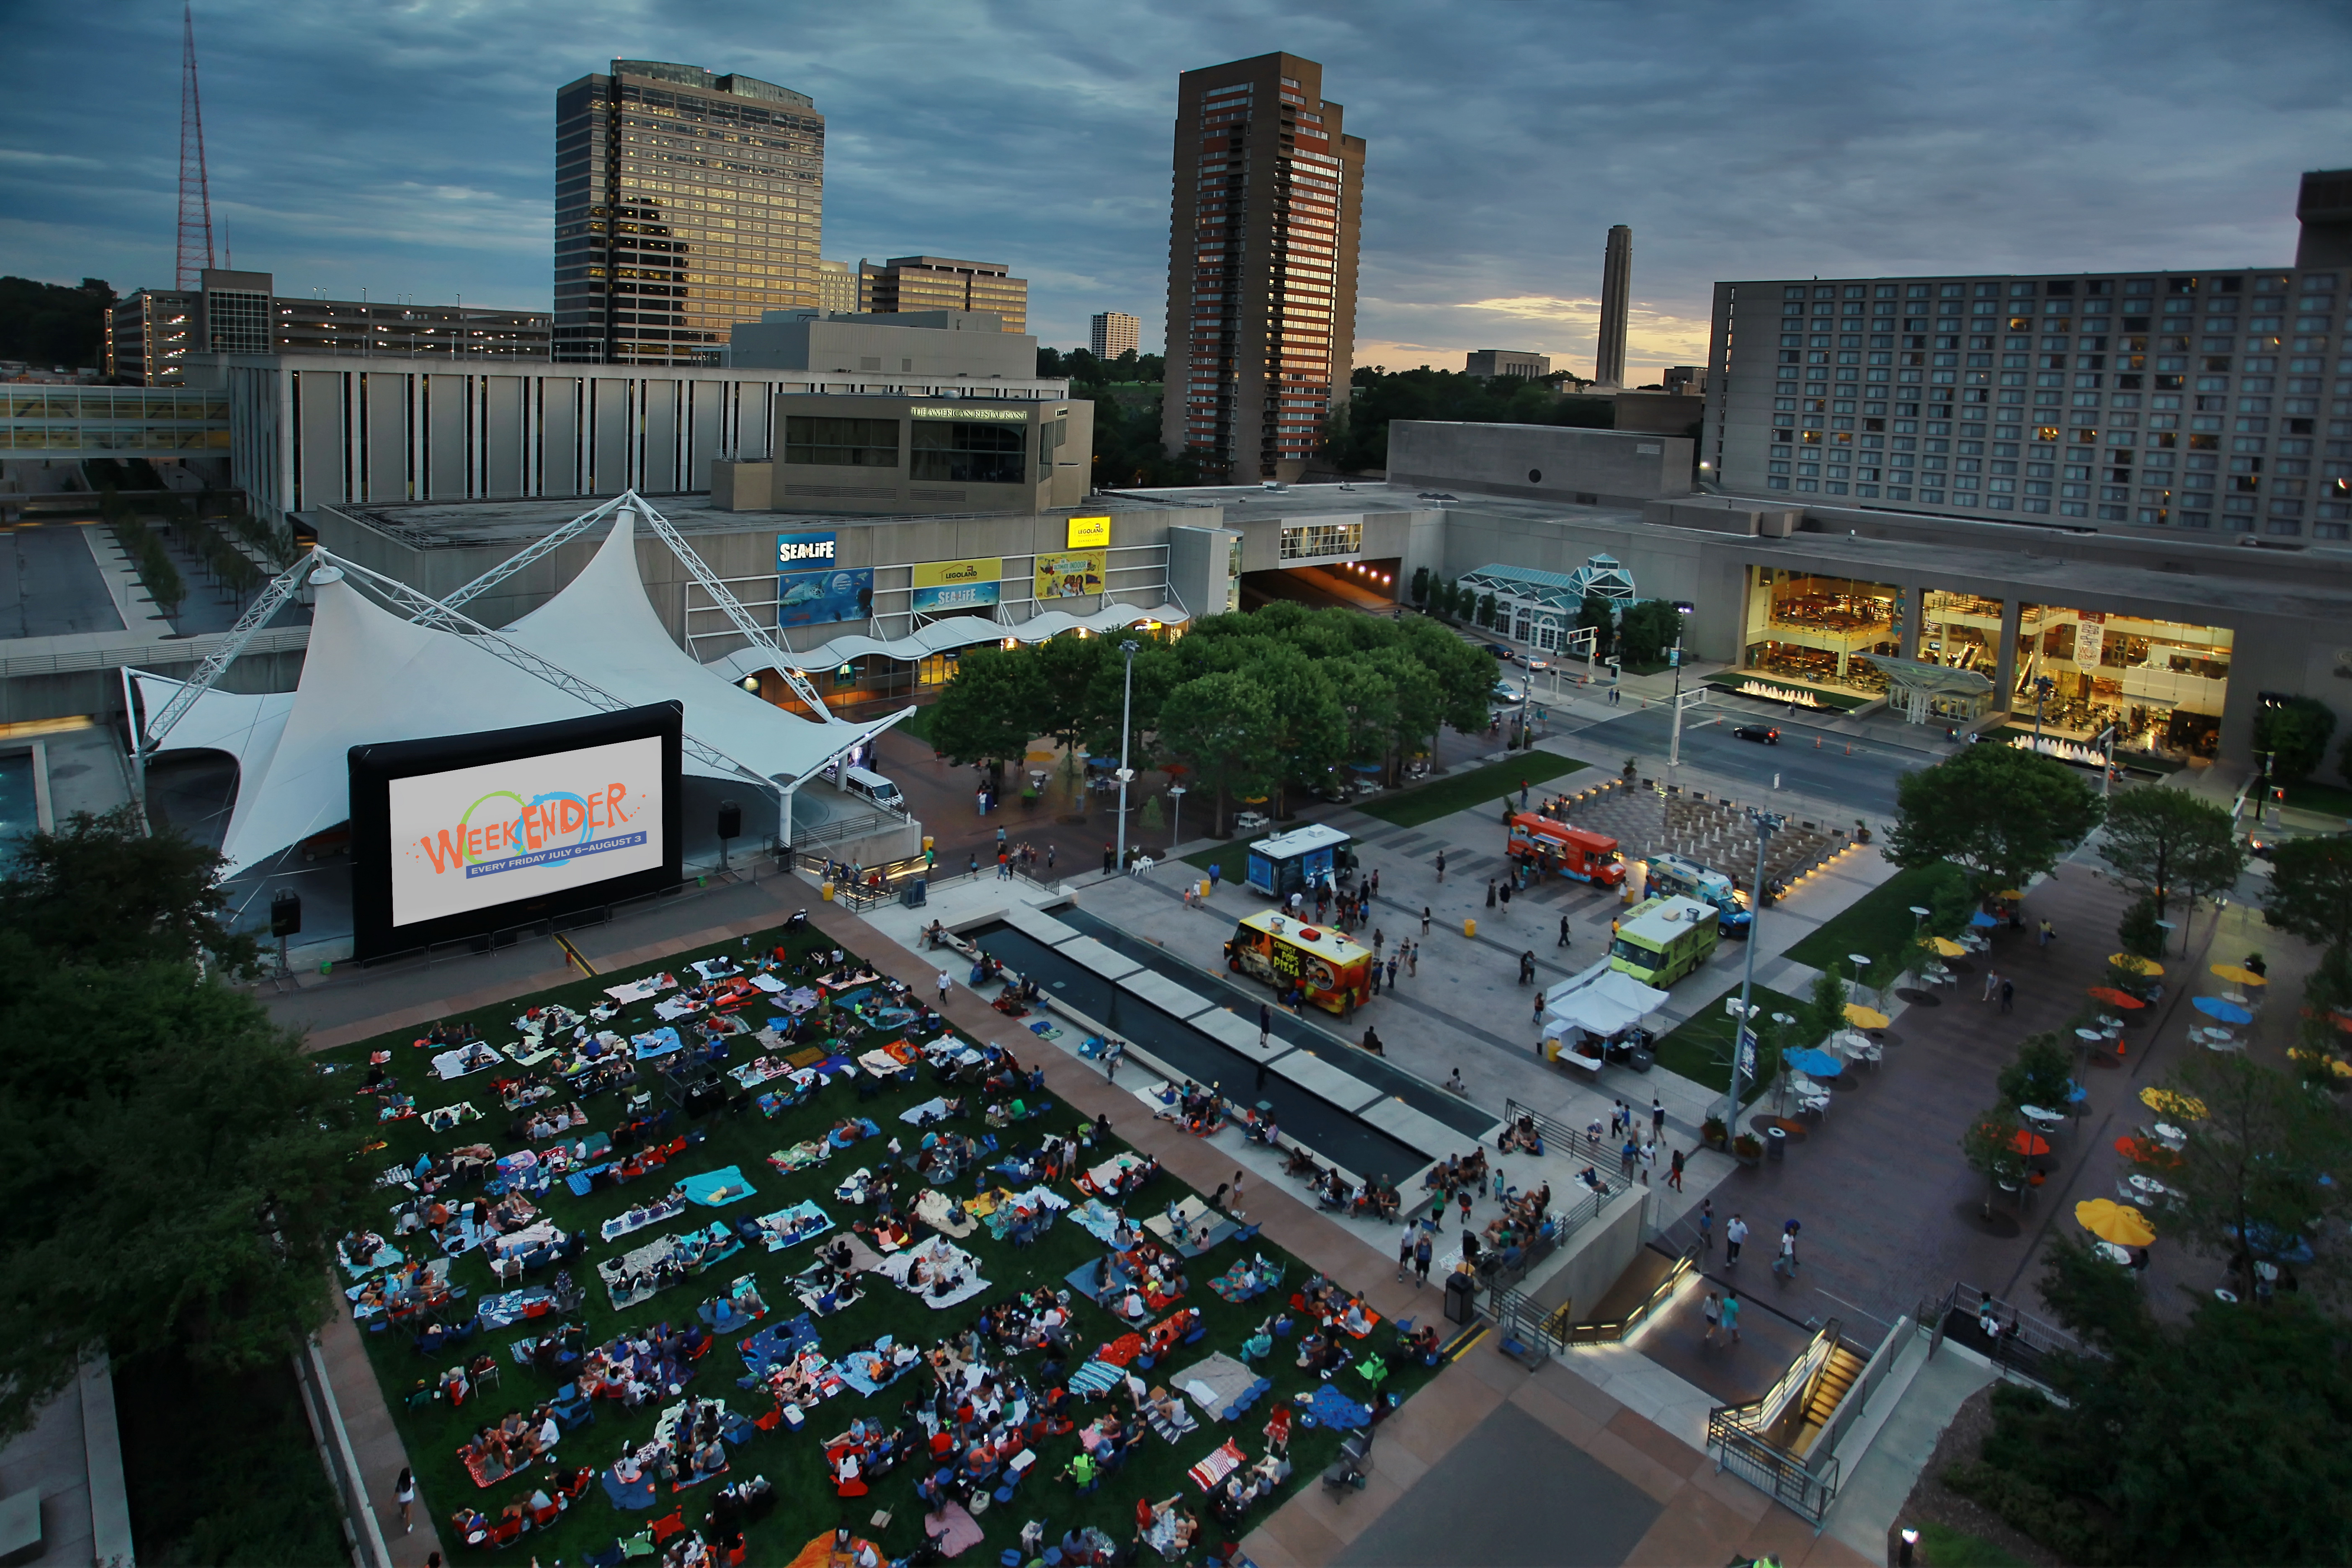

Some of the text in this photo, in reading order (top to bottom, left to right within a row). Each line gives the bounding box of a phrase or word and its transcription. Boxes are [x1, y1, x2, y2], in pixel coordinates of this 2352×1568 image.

[928, 408, 972, 418] AMERICAN
[974, 410, 1027, 419] RESTAURANT
[1078, 526, 1104, 534] LEGOLAND
[780, 543, 806, 562] SEA
[946, 568, 977, 579] LEGOLAND
[938, 591, 956, 605] SEA
[471, 862, 506, 874] EVERY
[509, 854, 546, 867] FRIDAY
[548, 849, 572, 859] JULY
[1282, 951, 1299, 966] POPS
[1274, 956, 1300, 977] PIZZA
